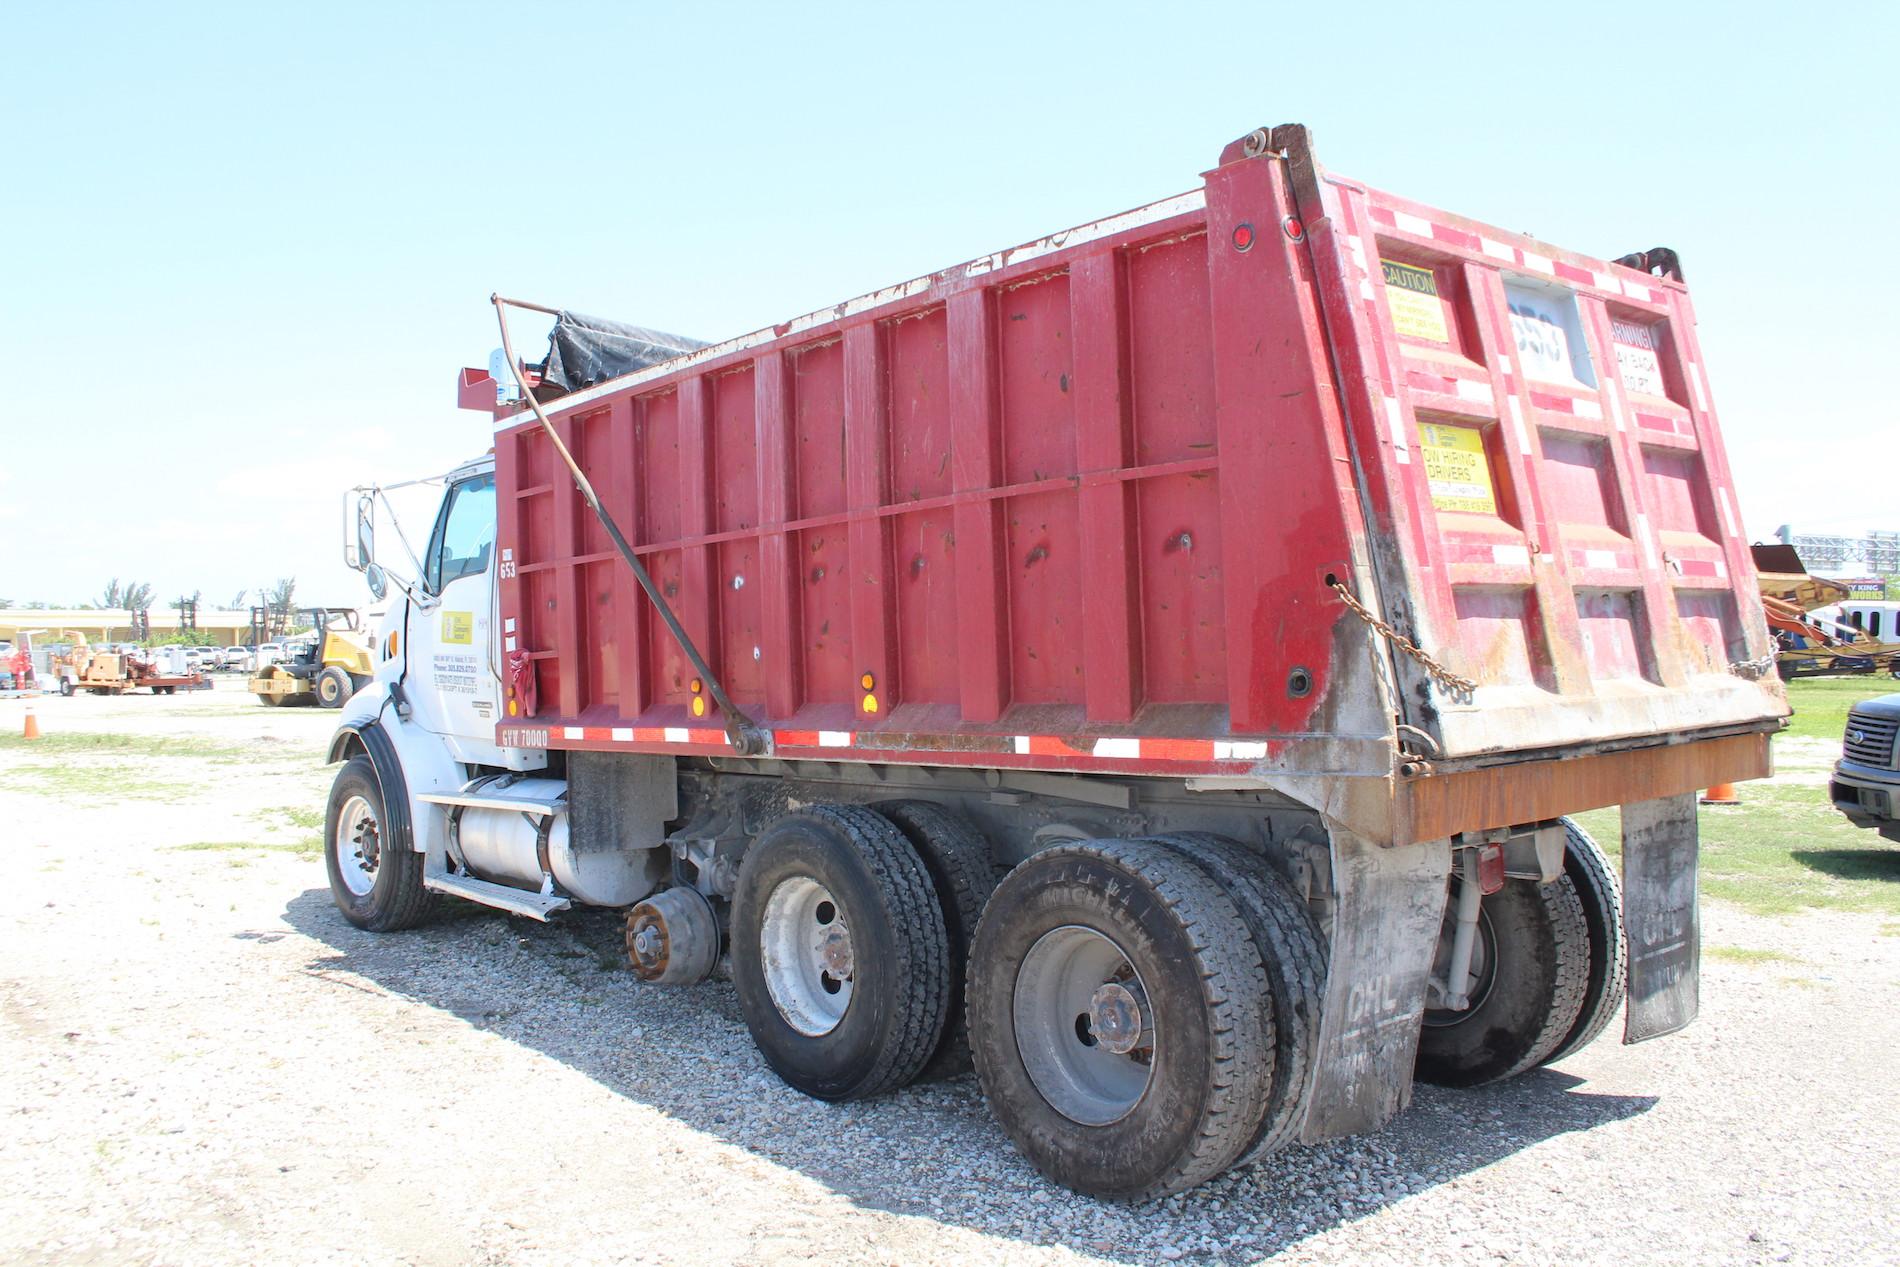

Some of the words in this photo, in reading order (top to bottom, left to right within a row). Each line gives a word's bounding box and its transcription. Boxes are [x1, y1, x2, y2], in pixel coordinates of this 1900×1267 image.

[1381, 265, 1434, 293] CAUTION
[1442, 451, 1476, 467] HIRING
[1428, 464, 1471, 481] DRIVERS
[500, 561, 516, 578] 653
